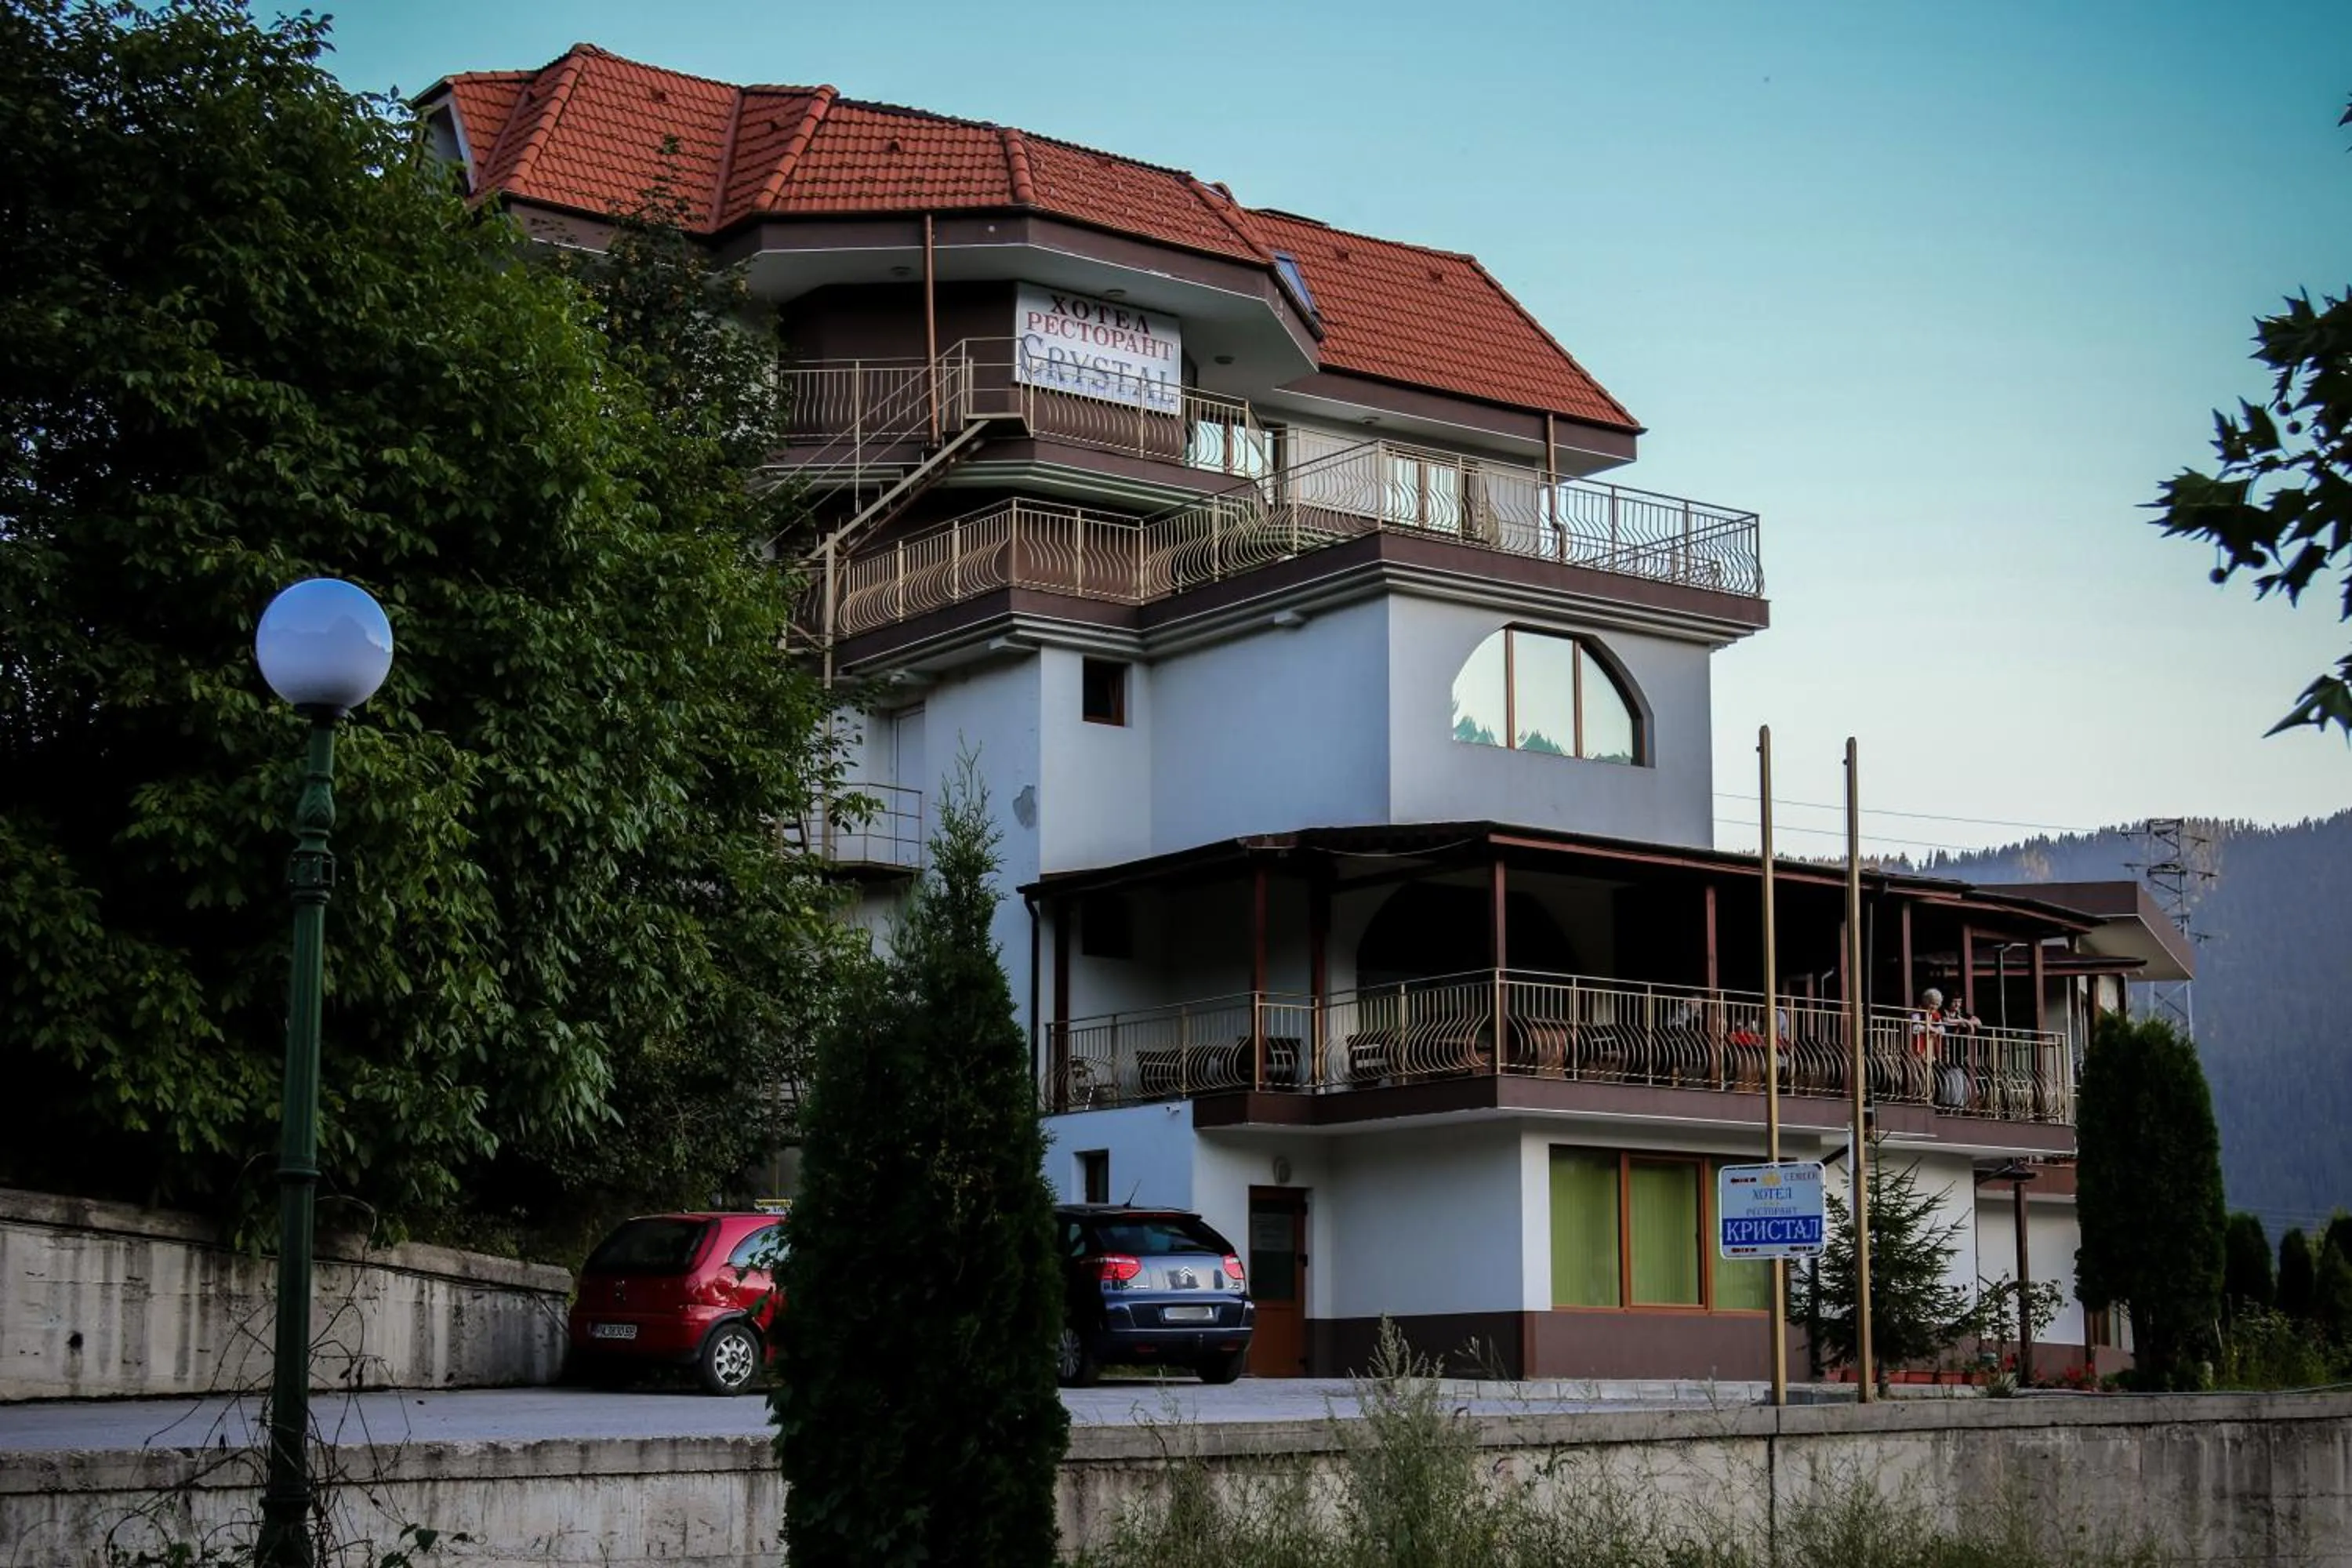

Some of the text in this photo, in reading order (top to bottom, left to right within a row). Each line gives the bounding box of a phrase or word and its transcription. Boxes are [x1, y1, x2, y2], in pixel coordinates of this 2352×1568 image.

[1050, 294, 1150, 335] ХОТЕЛ
[1026, 311, 1174, 361] РЕСТОРАНТ
[1726, 1219, 1820, 1242] КРИСТАЛ
